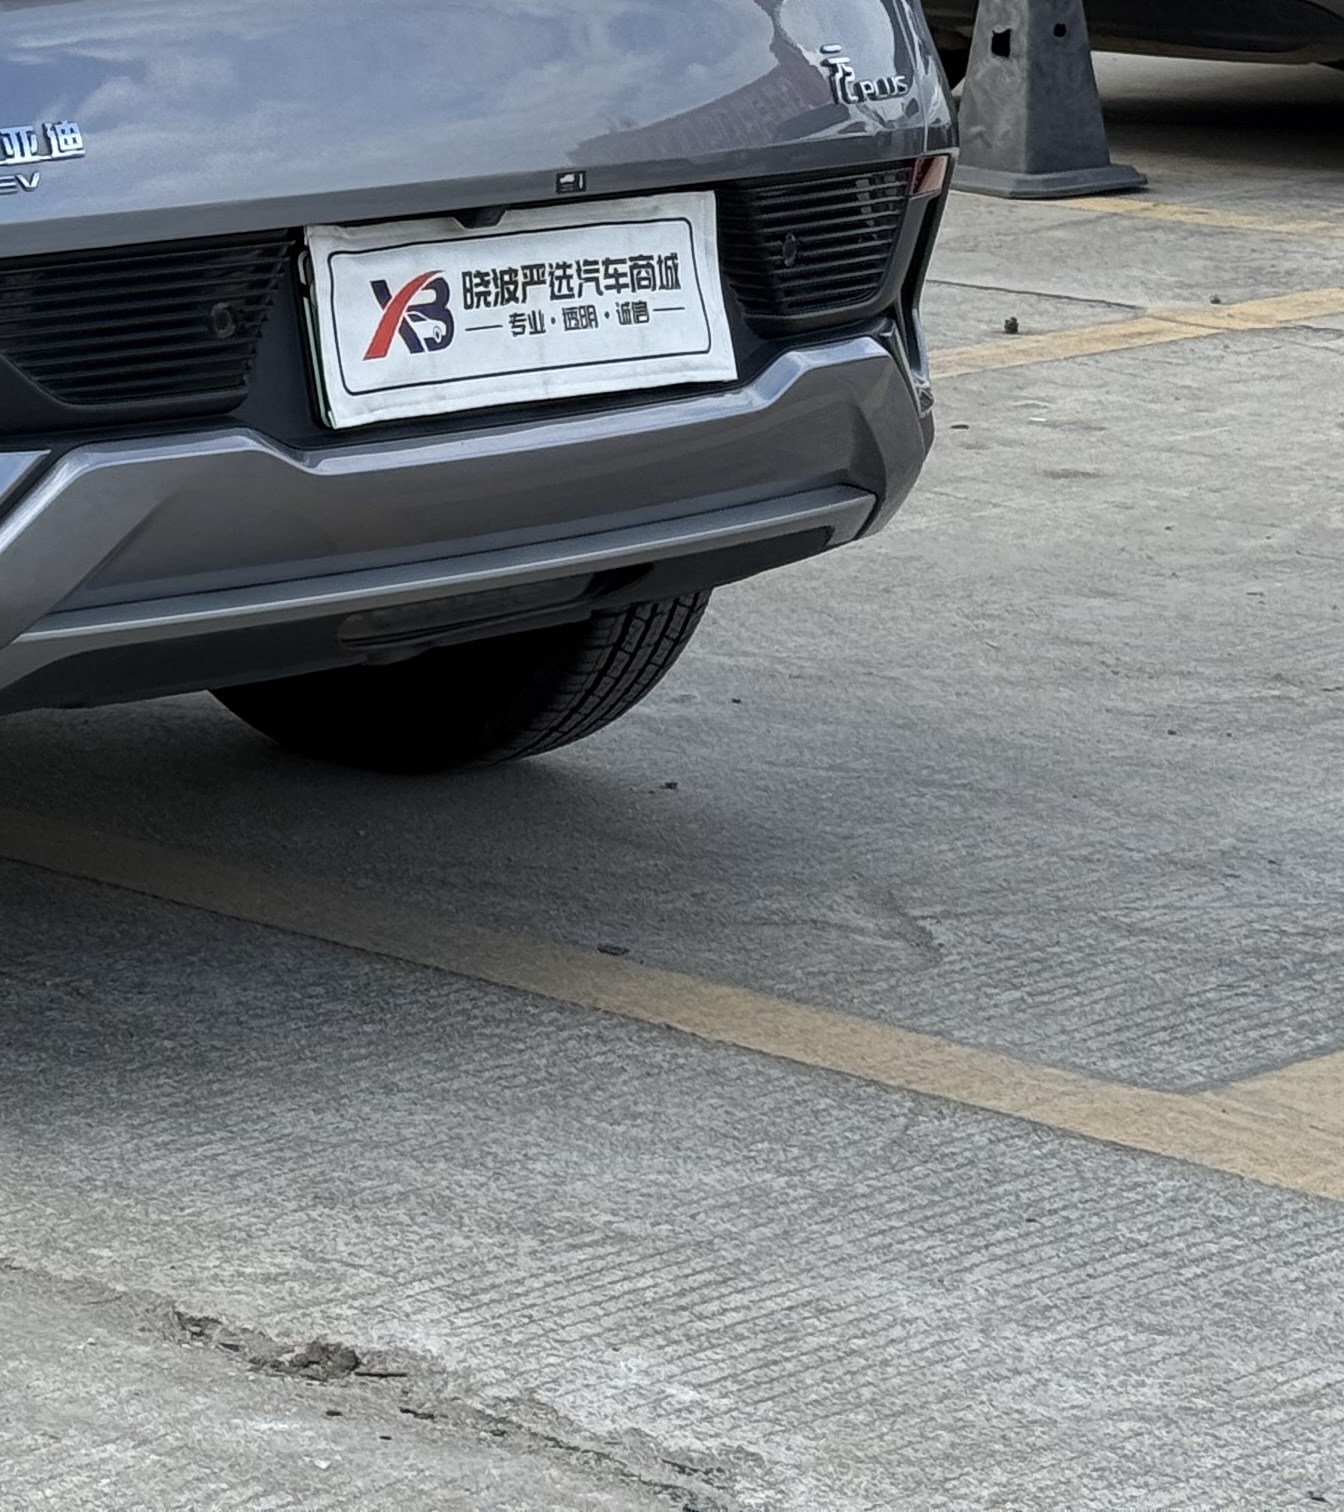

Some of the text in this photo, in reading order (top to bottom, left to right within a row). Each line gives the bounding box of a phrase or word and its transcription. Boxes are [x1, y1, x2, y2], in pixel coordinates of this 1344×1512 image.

[461, 252, 683, 310] 晓波严选汽车商城
